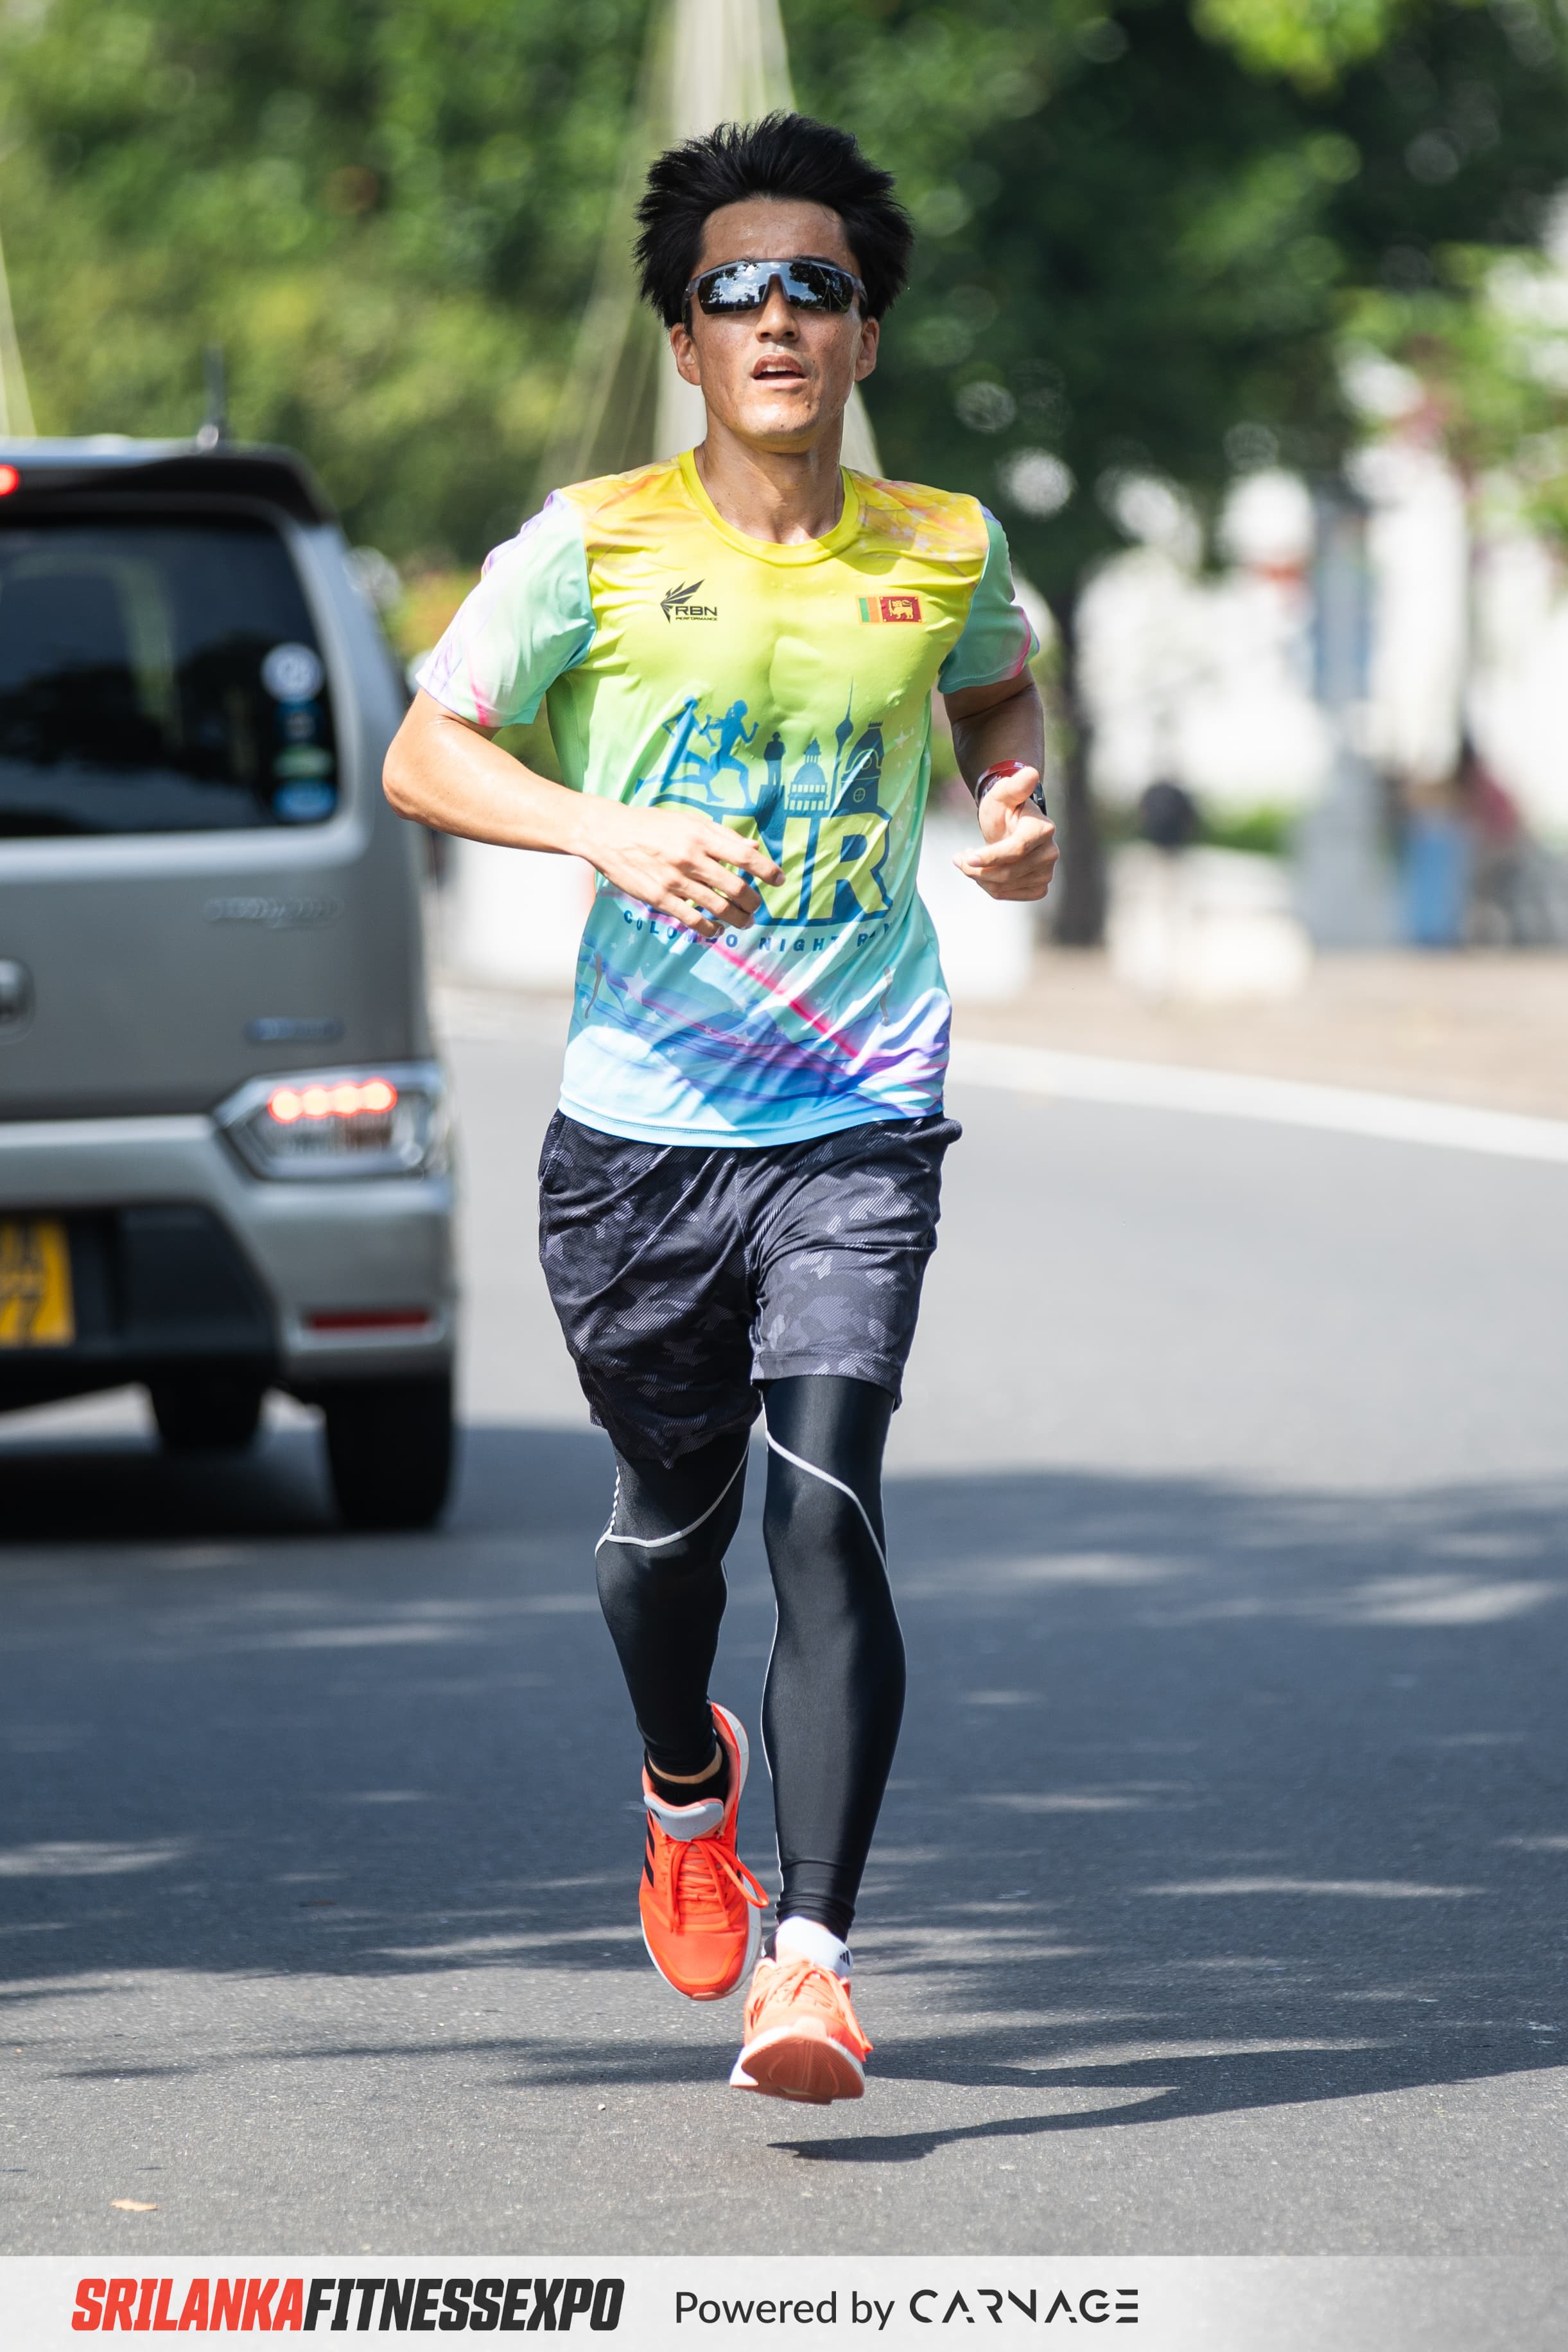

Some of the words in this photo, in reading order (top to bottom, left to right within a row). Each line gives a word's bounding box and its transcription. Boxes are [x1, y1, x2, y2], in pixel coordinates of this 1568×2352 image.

[675, 605, 718, 616] RBN
[650, 800, 892, 920] NR
[623, 910, 738, 948] COLOO
